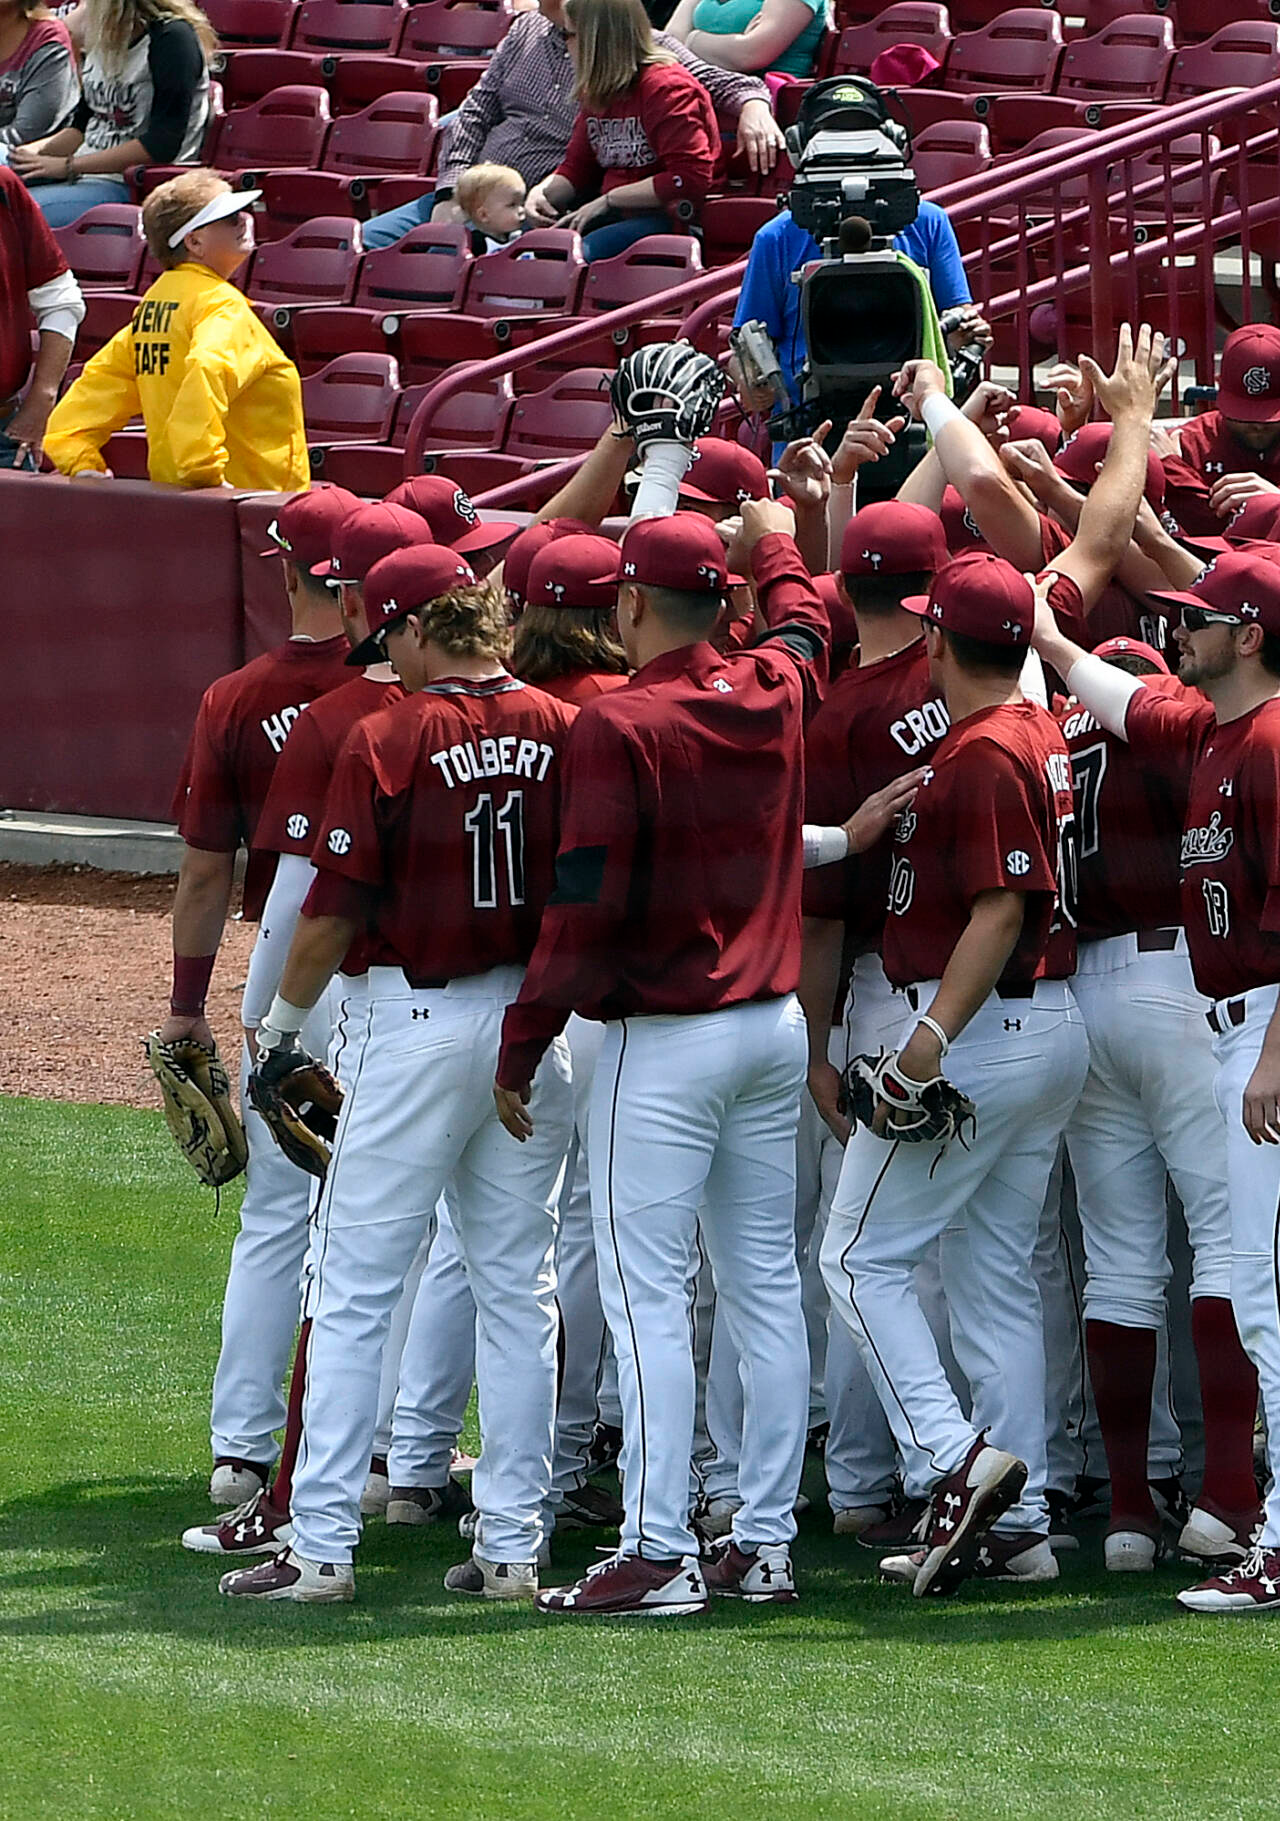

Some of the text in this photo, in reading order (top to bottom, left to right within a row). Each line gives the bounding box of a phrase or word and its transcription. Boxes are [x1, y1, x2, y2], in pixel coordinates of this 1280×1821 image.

[890, 698, 951, 756] CRO
[430, 736, 555, 789] TOLBERT
[286, 813, 309, 839] SEC
[327, 828, 351, 854] SEC
[464, 789, 526, 909] 11
[1006, 850, 1031, 876] SEC
